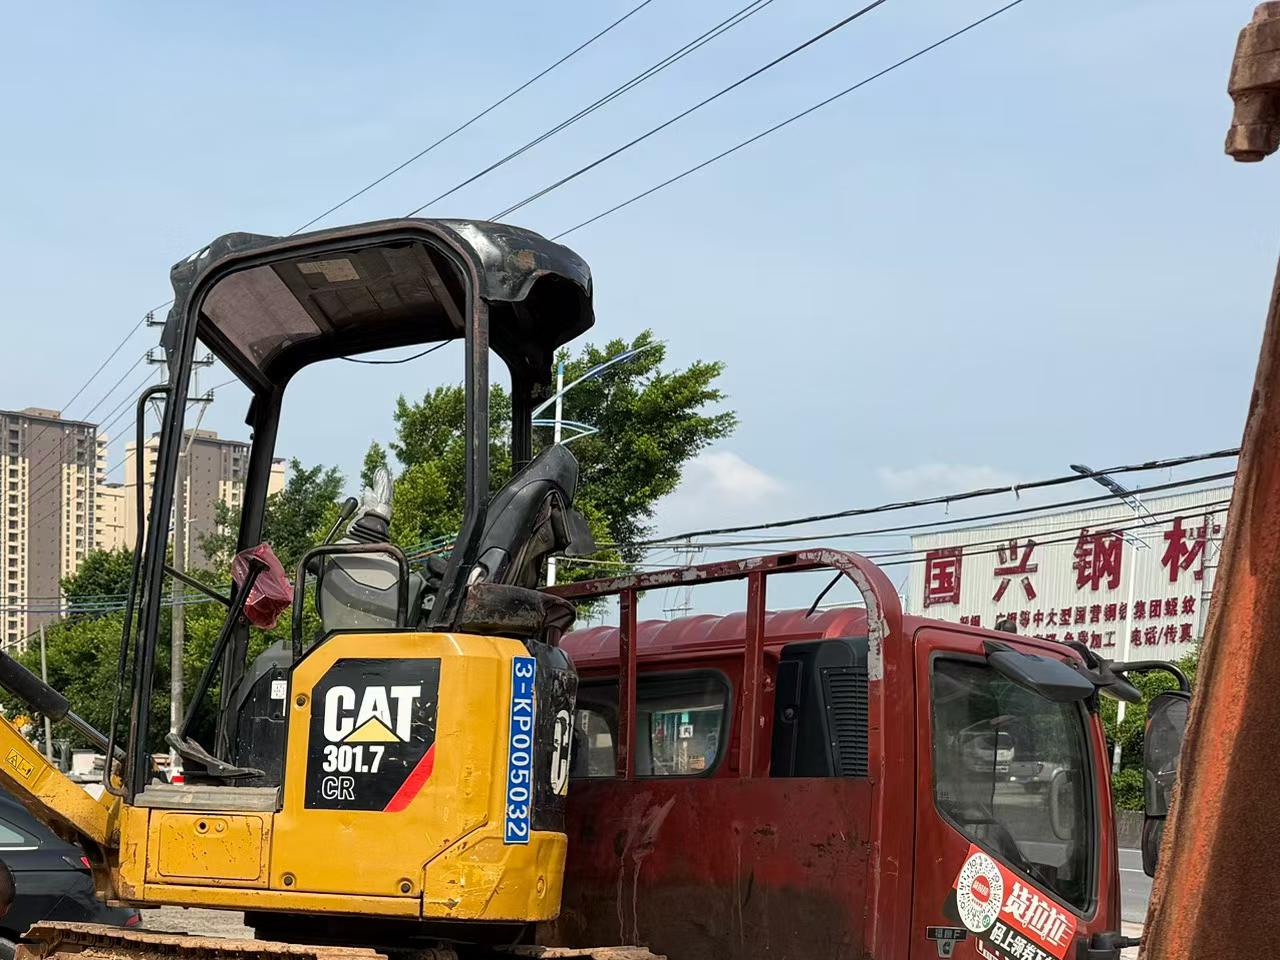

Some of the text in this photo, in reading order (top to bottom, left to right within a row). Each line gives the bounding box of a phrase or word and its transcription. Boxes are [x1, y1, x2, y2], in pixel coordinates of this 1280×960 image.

[923, 516, 1209, 609] 国兴钢材
[1130, 622, 1193, 647] 电话/传真
[323, 685, 422, 743] CAT
[322, 744, 385, 774] 301.7
[507, 661, 534, 837] 3-KP005032
[321, 776, 355, 801] CR
[1002, 880, 1071, 947] 货拉拉
